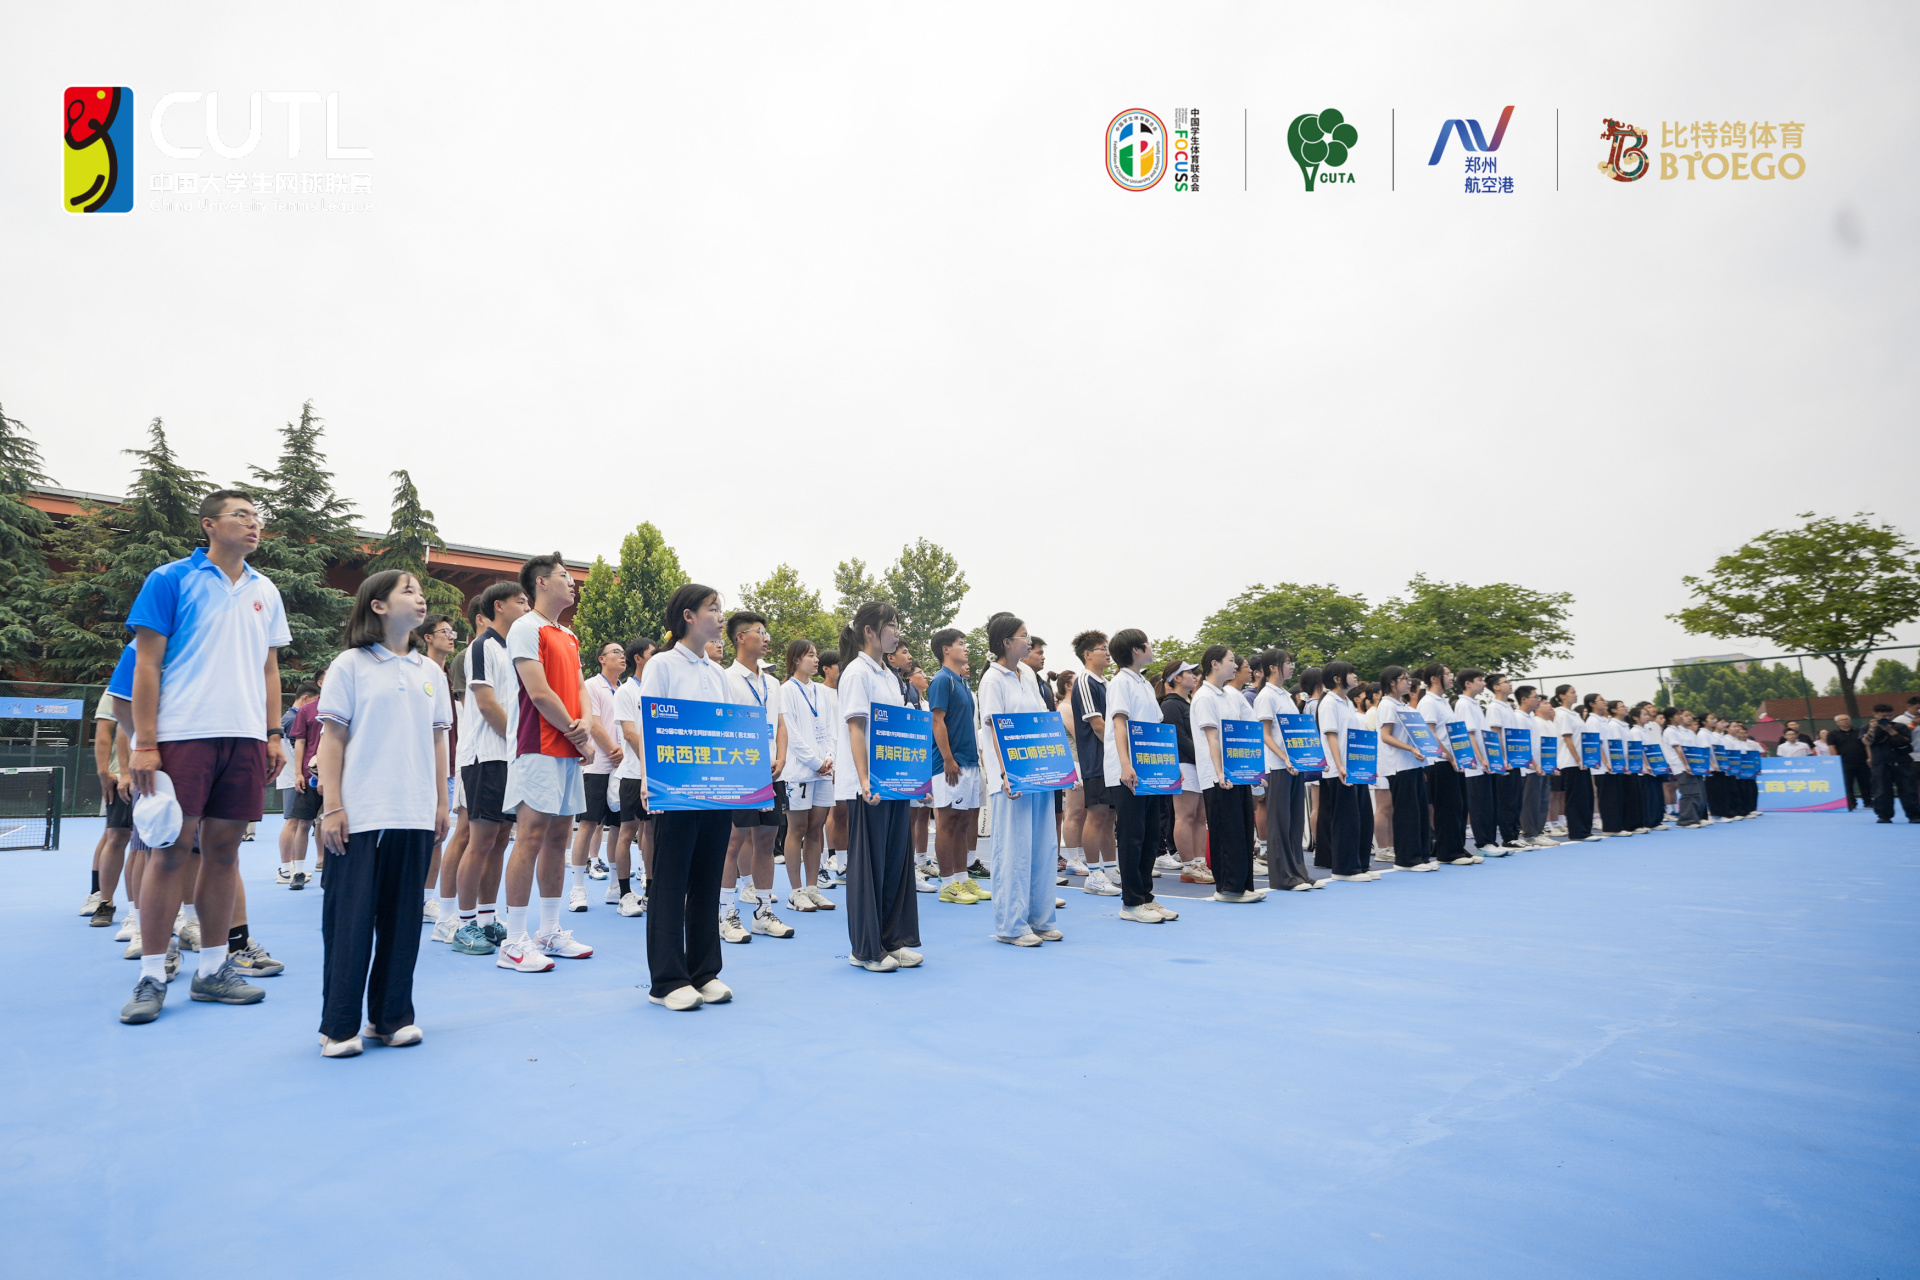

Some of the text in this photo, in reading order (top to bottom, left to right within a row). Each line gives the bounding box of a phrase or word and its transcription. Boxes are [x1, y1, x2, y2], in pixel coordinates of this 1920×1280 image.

[658, 704, 679, 714] CUTL
[1286, 737, 1321, 749] 太原理工大学
[657, 745, 760, 765] 陕西理工大学
[875, 745, 927, 762] 青海民族大学
[1006, 744, 1066, 761] 周口师范学院
[1226, 747, 1262, 759] 河南师范大学
[799, 782, 807, 799] 7
